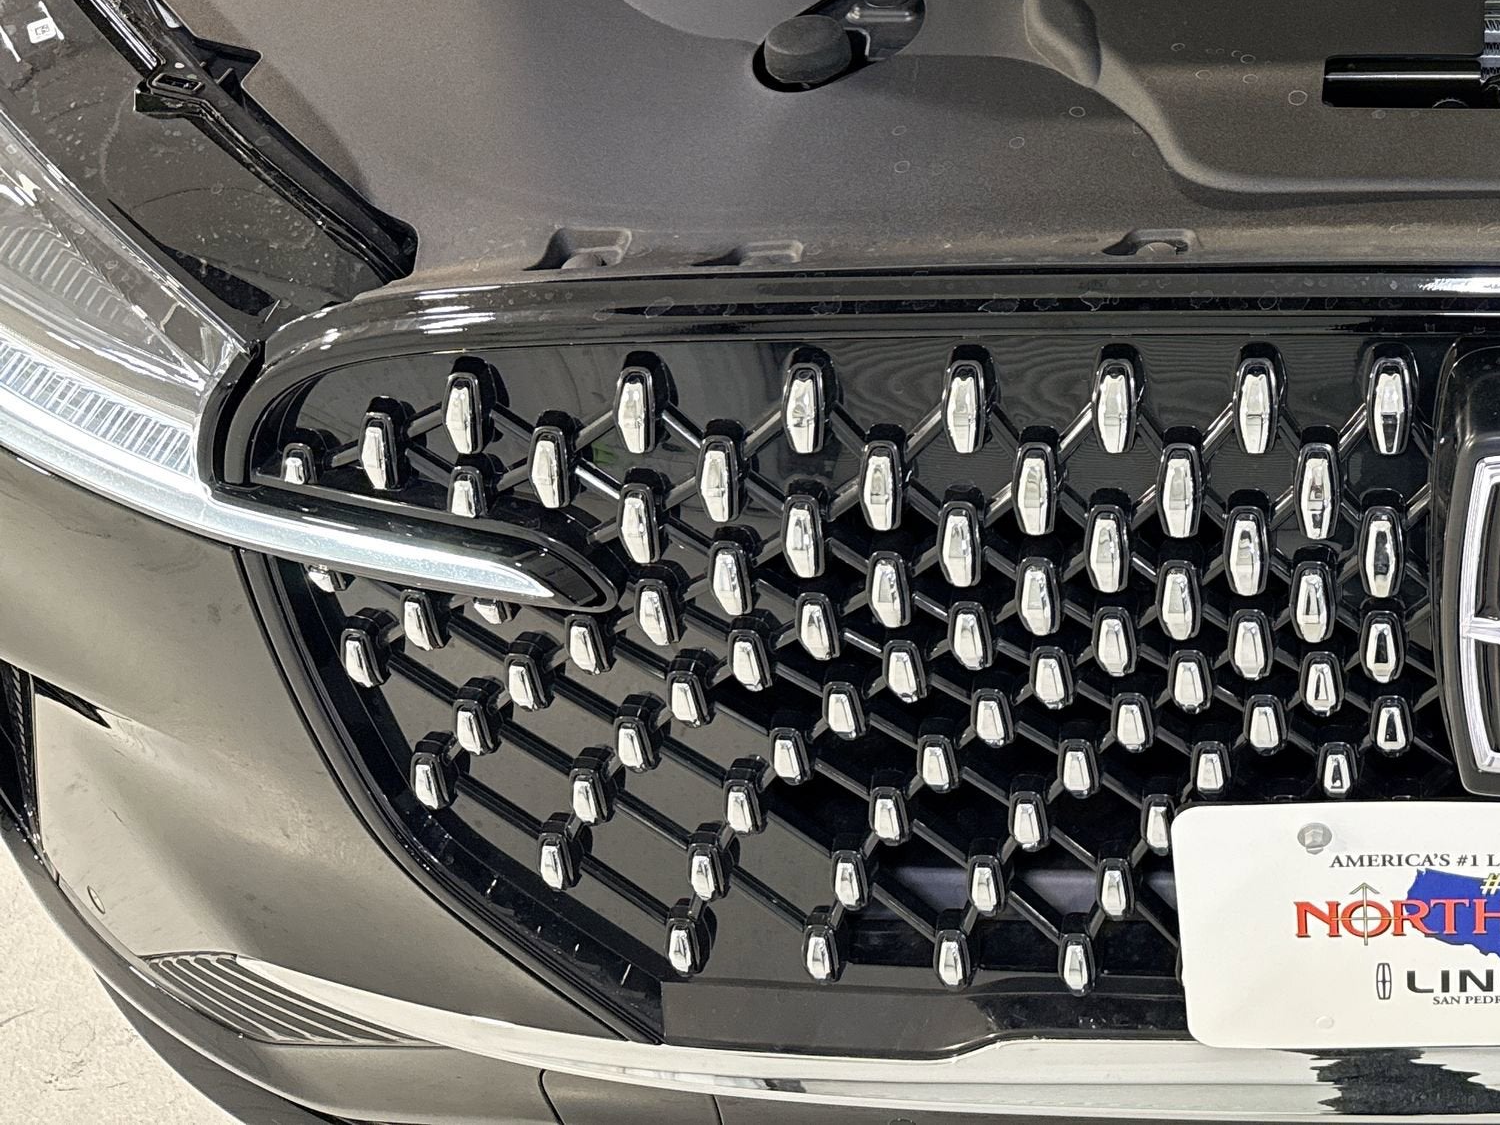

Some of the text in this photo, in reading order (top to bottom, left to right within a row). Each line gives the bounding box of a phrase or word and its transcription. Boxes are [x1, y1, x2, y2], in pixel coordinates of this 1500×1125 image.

[1328, 853, 1450, 867] AMERICA'S
[1456, 854, 1479, 867] #1
[1432, 995, 1461, 1005] SAN
